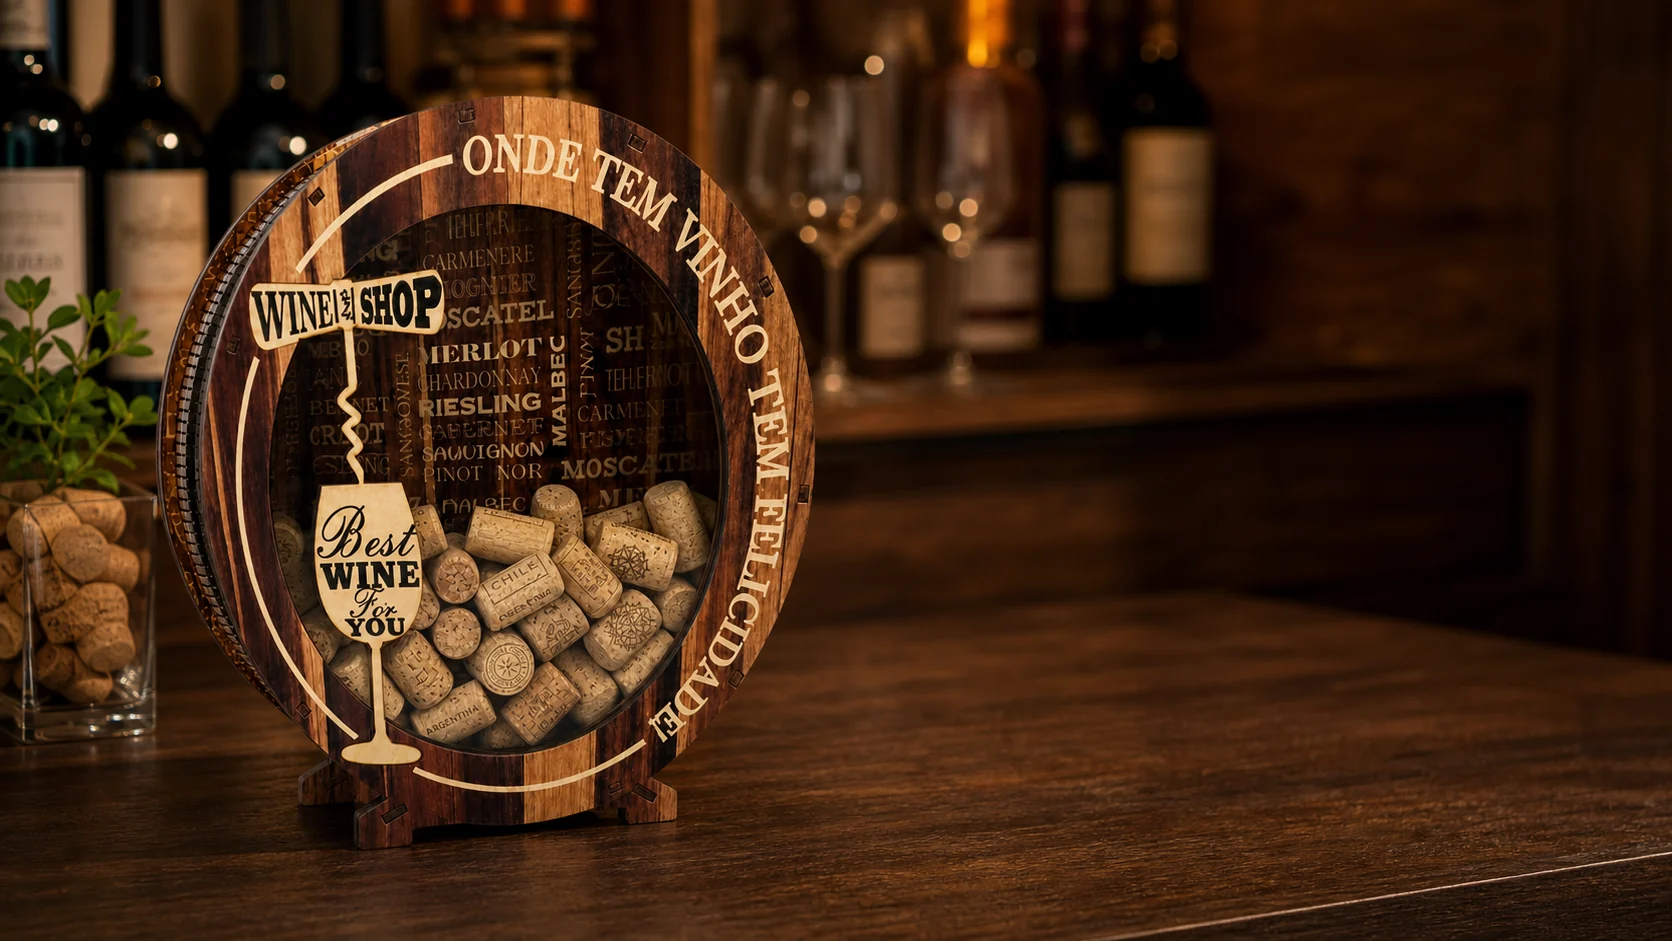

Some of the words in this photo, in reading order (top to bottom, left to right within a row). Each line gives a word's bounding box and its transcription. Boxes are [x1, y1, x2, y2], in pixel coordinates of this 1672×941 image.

[463, 134, 582, 183] ONDE
[591, 148, 678, 232] TEM
[423, 244, 535, 271] CARMENERE
[443, 272, 536, 299] IOGNIER
[675, 208, 769, 364] VINHO
[251, 291, 333, 342] WINE
[360, 275, 441, 329] SHOP
[441, 300, 554, 330] SCATEL
[418, 337, 542, 365] MERLOT
[418, 366, 541, 392] CHARDONNAY
[550, 335, 568, 447] MALBEC
[418, 392, 542, 418] RIESLING
[748, 368, 789, 484] TEM
[423, 465, 483, 483] PINOT
[497, 462, 543, 480] NOR
[317, 505, 417, 558] Best
[320, 561, 420, 590] WINE
[491, 560, 539, 591] CHILE
[350, 588, 397, 618] For
[648, 493, 788, 743] FELICIDADE!
[345, 617, 405, 636] YOU
[426, 704, 480, 736] ARGENTINA
